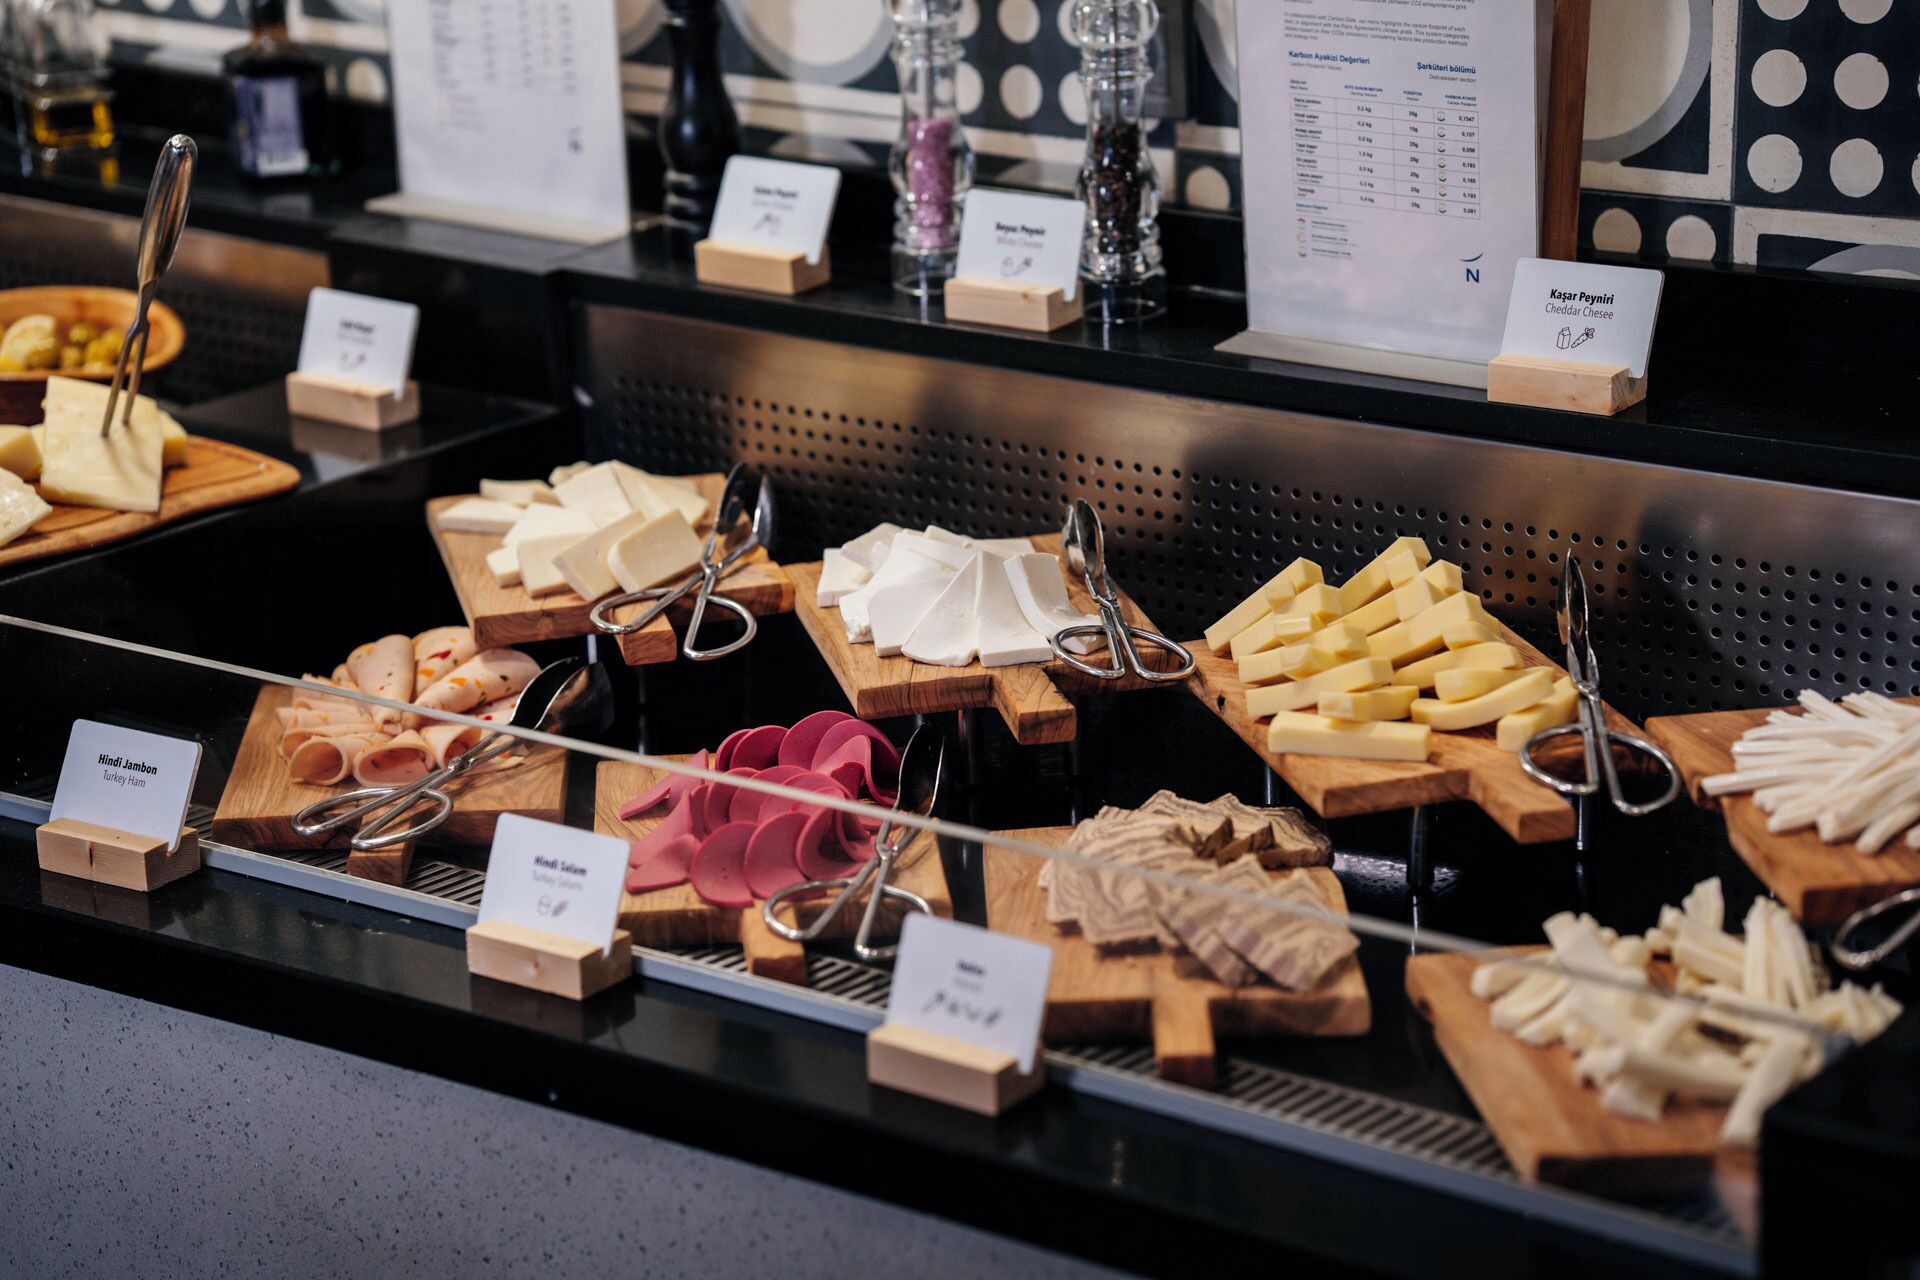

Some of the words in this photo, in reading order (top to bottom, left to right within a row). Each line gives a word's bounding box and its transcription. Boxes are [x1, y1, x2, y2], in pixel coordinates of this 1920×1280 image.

[1288, 50, 1314, 59] Karbon
[1340, 54, 1370, 64] Değerleri
[1416, 62, 1448, 72] Şarküteri
[1450, 64, 1476, 74] bölümü
[1466, 268, 1480, 283] N
[1550, 288, 1578, 303] Kaşar
[1578, 291, 1615, 306] Peyniri
[1545, 302, 1582, 317] Cheddar
[1582, 306, 1614, 320] Chesee
[98, 754, 122, 768] Hindi
[122, 759, 158, 775] Jambon
[103, 770, 127, 787] Turkey
[128, 774, 146, 788] Ham
[533, 856, 558, 870] Hindi
